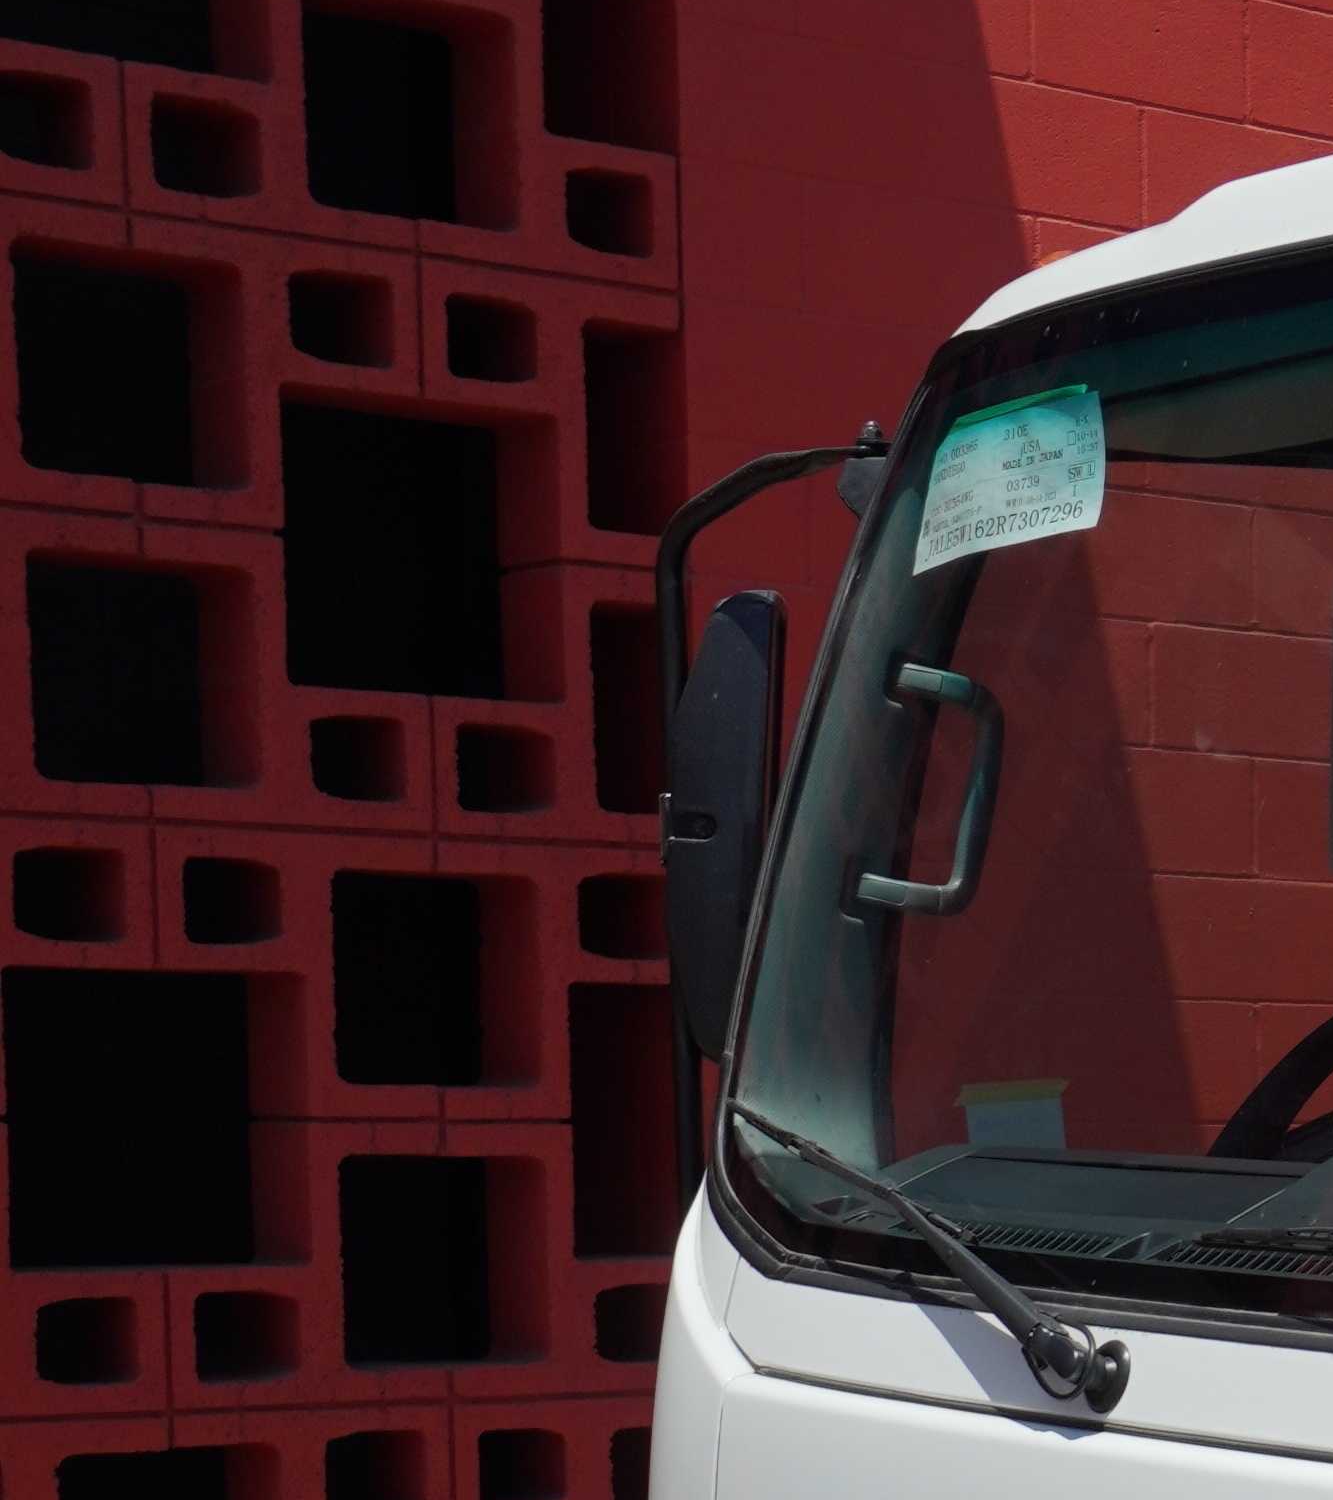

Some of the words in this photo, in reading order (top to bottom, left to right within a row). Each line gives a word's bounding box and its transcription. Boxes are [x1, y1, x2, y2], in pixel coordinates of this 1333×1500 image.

[1002, 458, 1022, 471] MADE
[1025, 455, 1035, 466] IN
[1038, 449, 1064, 463] JAPAN
[1006, 474, 1040, 493] 03739
